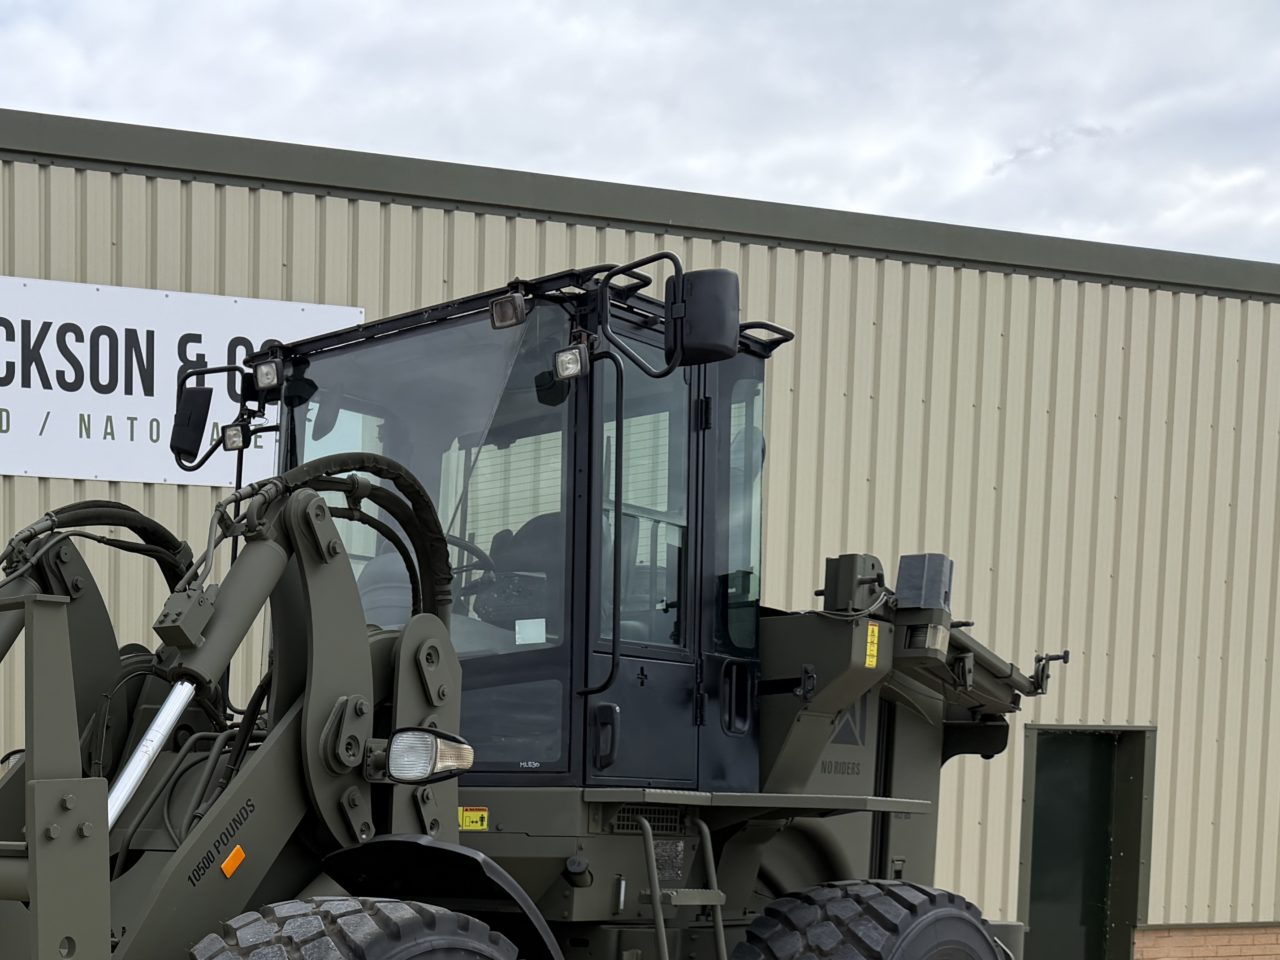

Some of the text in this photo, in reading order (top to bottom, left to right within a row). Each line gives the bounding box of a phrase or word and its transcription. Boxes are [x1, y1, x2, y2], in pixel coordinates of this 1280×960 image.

[177, 333, 208, 389] &
[38, 411, 51, 436] /
[78, 413, 161, 443] NATO
[821, 760, 861, 776] NO RIDERS
[187, 798, 256, 887] 10500 POUNDS
